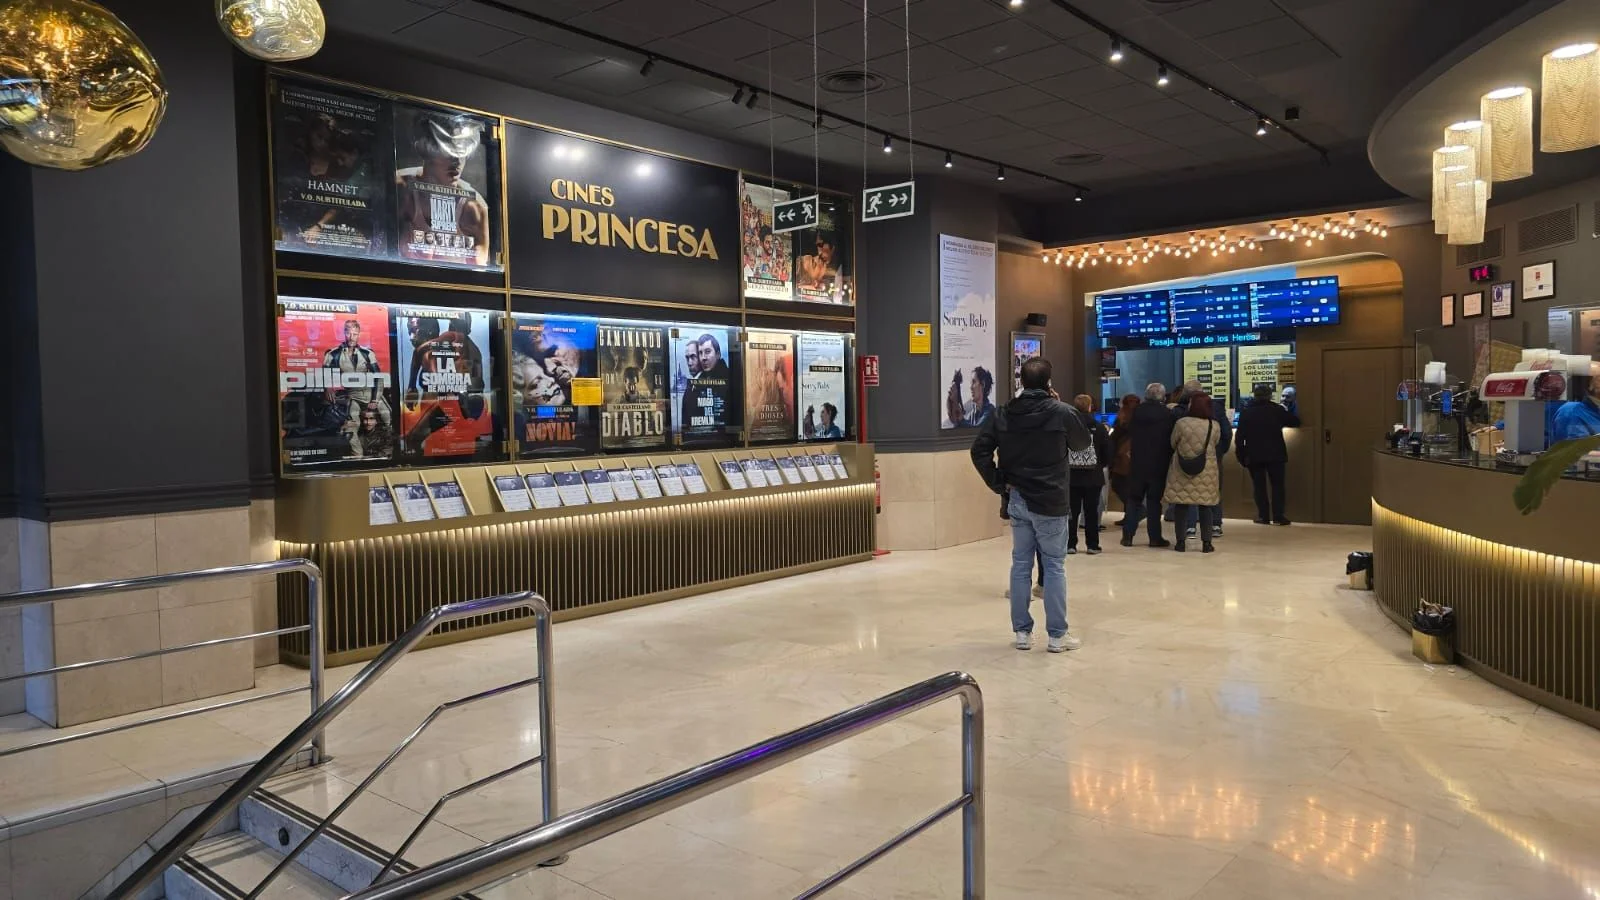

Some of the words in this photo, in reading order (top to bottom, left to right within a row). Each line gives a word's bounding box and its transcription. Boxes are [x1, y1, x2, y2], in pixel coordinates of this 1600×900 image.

[308, 180, 359, 195] HAMNET
[551, 178, 615, 207] CINES
[542, 203, 719, 260] PRINCESA
[969, 313, 988, 332] Baby
[599, 329, 661, 349] CAMINANDO
[1149, 338, 1174, 346] Pasaje
[1177, 335, 1201, 345] Martín
[1204, 335, 1214, 343] de
[436, 357, 457, 373] LA
[280, 367, 391, 393] pillion
[422, 372, 472, 386] SOMBRA
[602, 411, 664, 437] DIABLO
